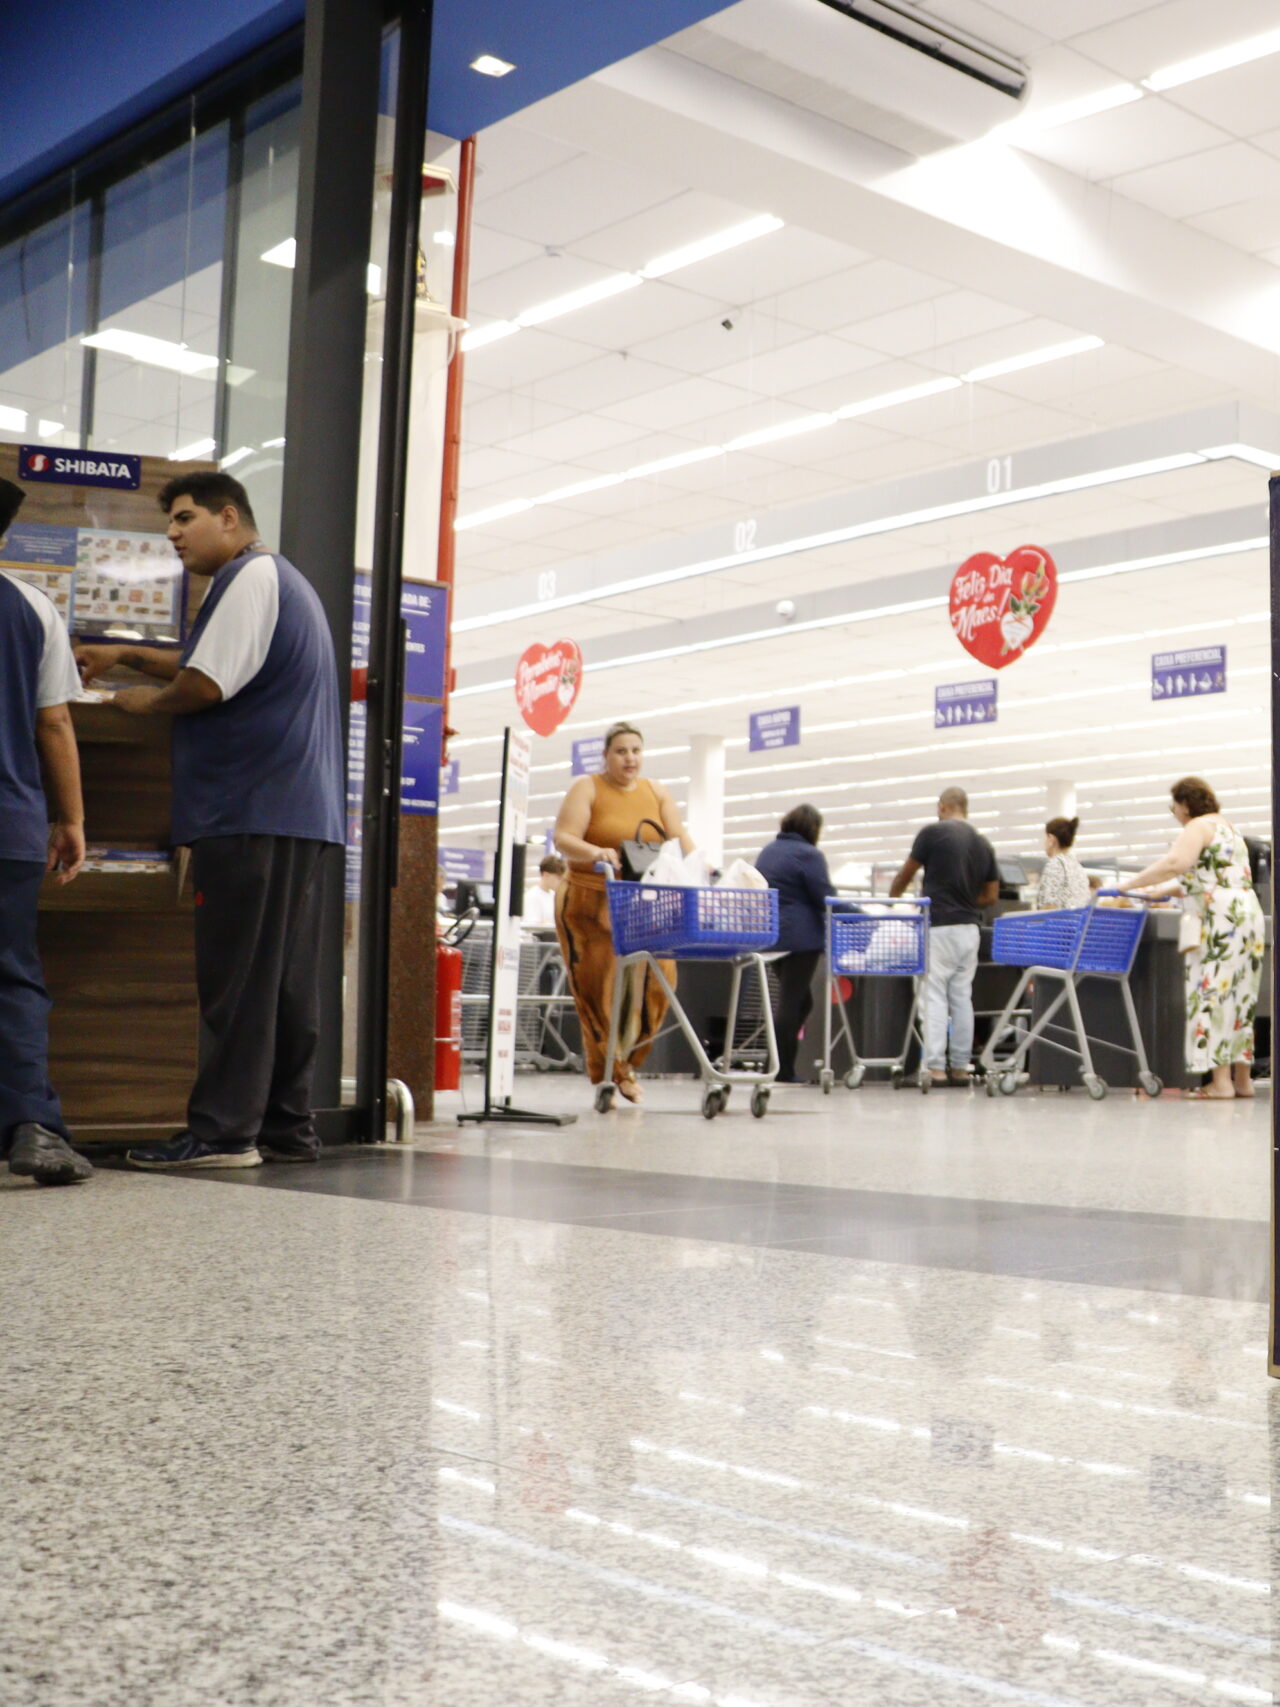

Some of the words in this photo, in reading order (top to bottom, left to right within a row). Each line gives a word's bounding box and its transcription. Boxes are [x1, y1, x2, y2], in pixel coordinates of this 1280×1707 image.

[54, 457, 131, 480] SHIBATA
[986, 455, 1013, 494] 01
[734, 518, 757, 553] 02
[537, 570, 557, 601] 03
